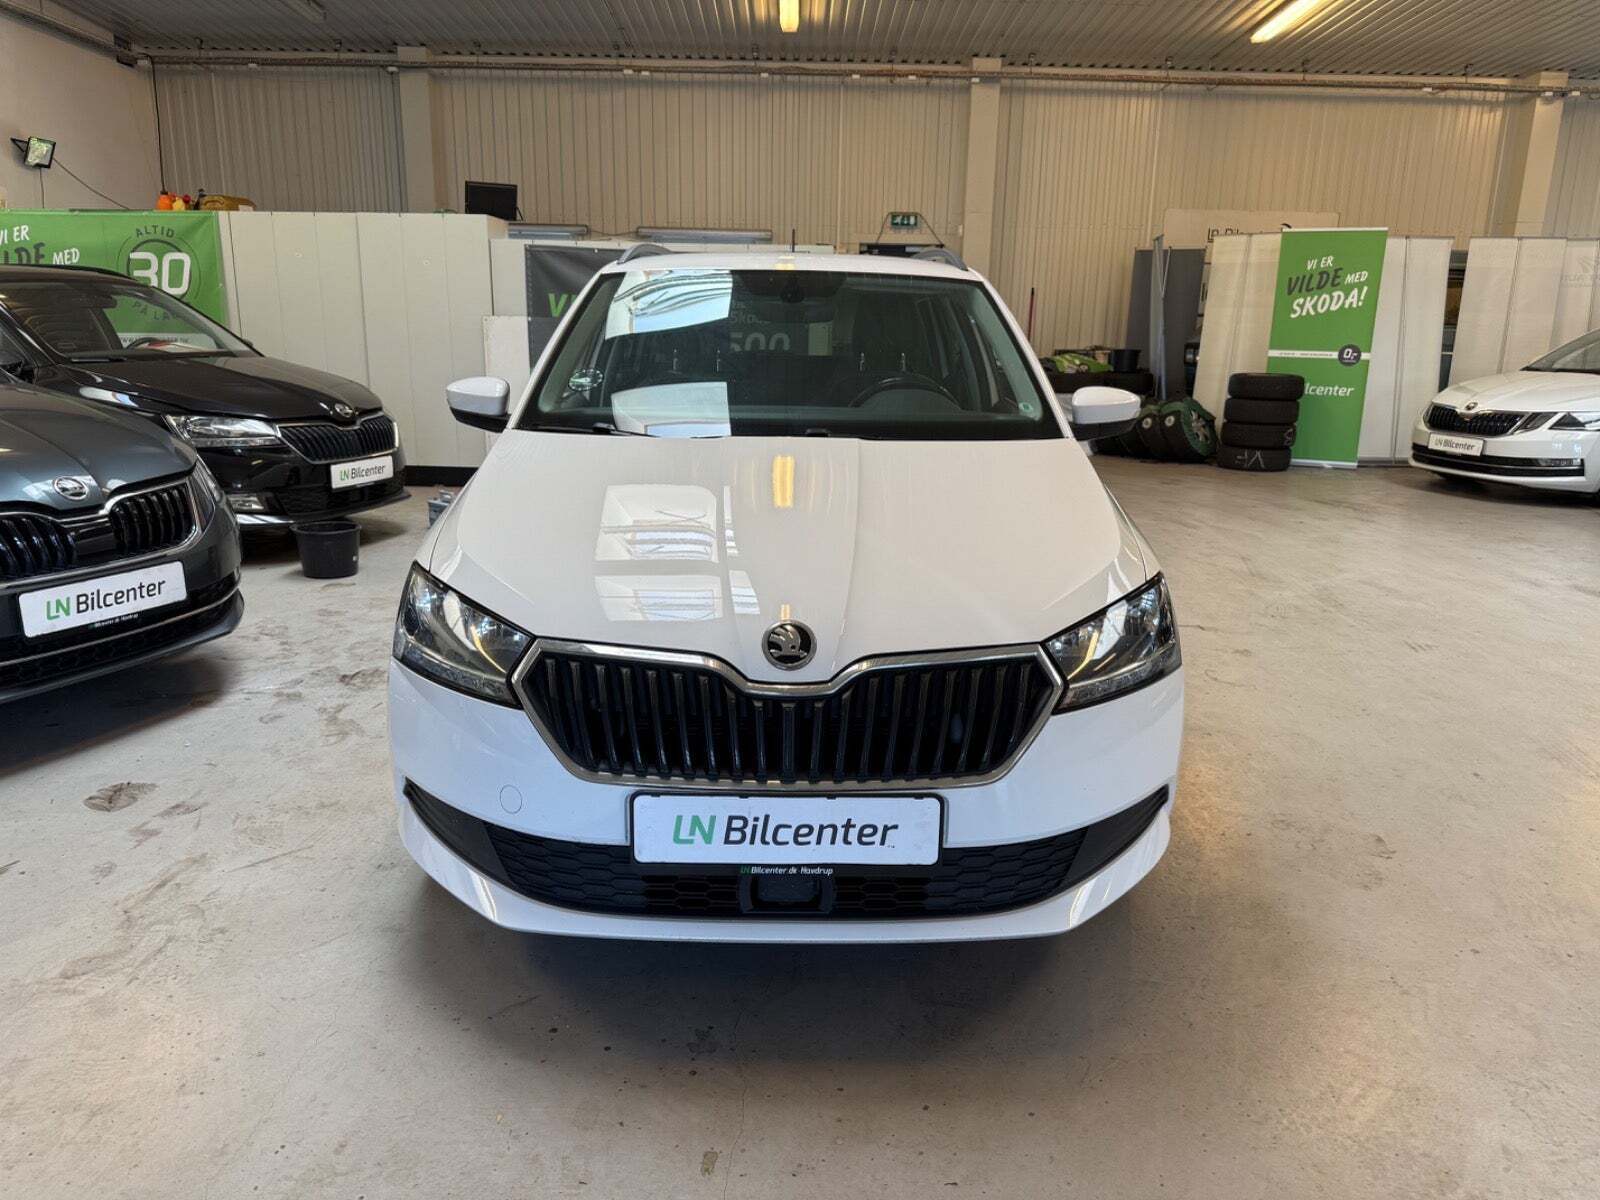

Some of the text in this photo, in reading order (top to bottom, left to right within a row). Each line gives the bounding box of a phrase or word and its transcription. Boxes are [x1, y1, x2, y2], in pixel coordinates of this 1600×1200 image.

[13, 225, 30, 242] ER
[136, 225, 175, 238] ALTID
[52, 247, 80, 265] MED
[1307, 255, 1334, 270] VI ER
[129, 251, 191, 295] 30
[1287, 267, 1368, 295] VILDE MED
[1290, 286, 1368, 318] SKODA!
[340, 464, 386, 481] LN Bilcenter
[46, 580, 166, 620] LN Bilcenter
[672, 814, 899, 846] LN Bilcenter
